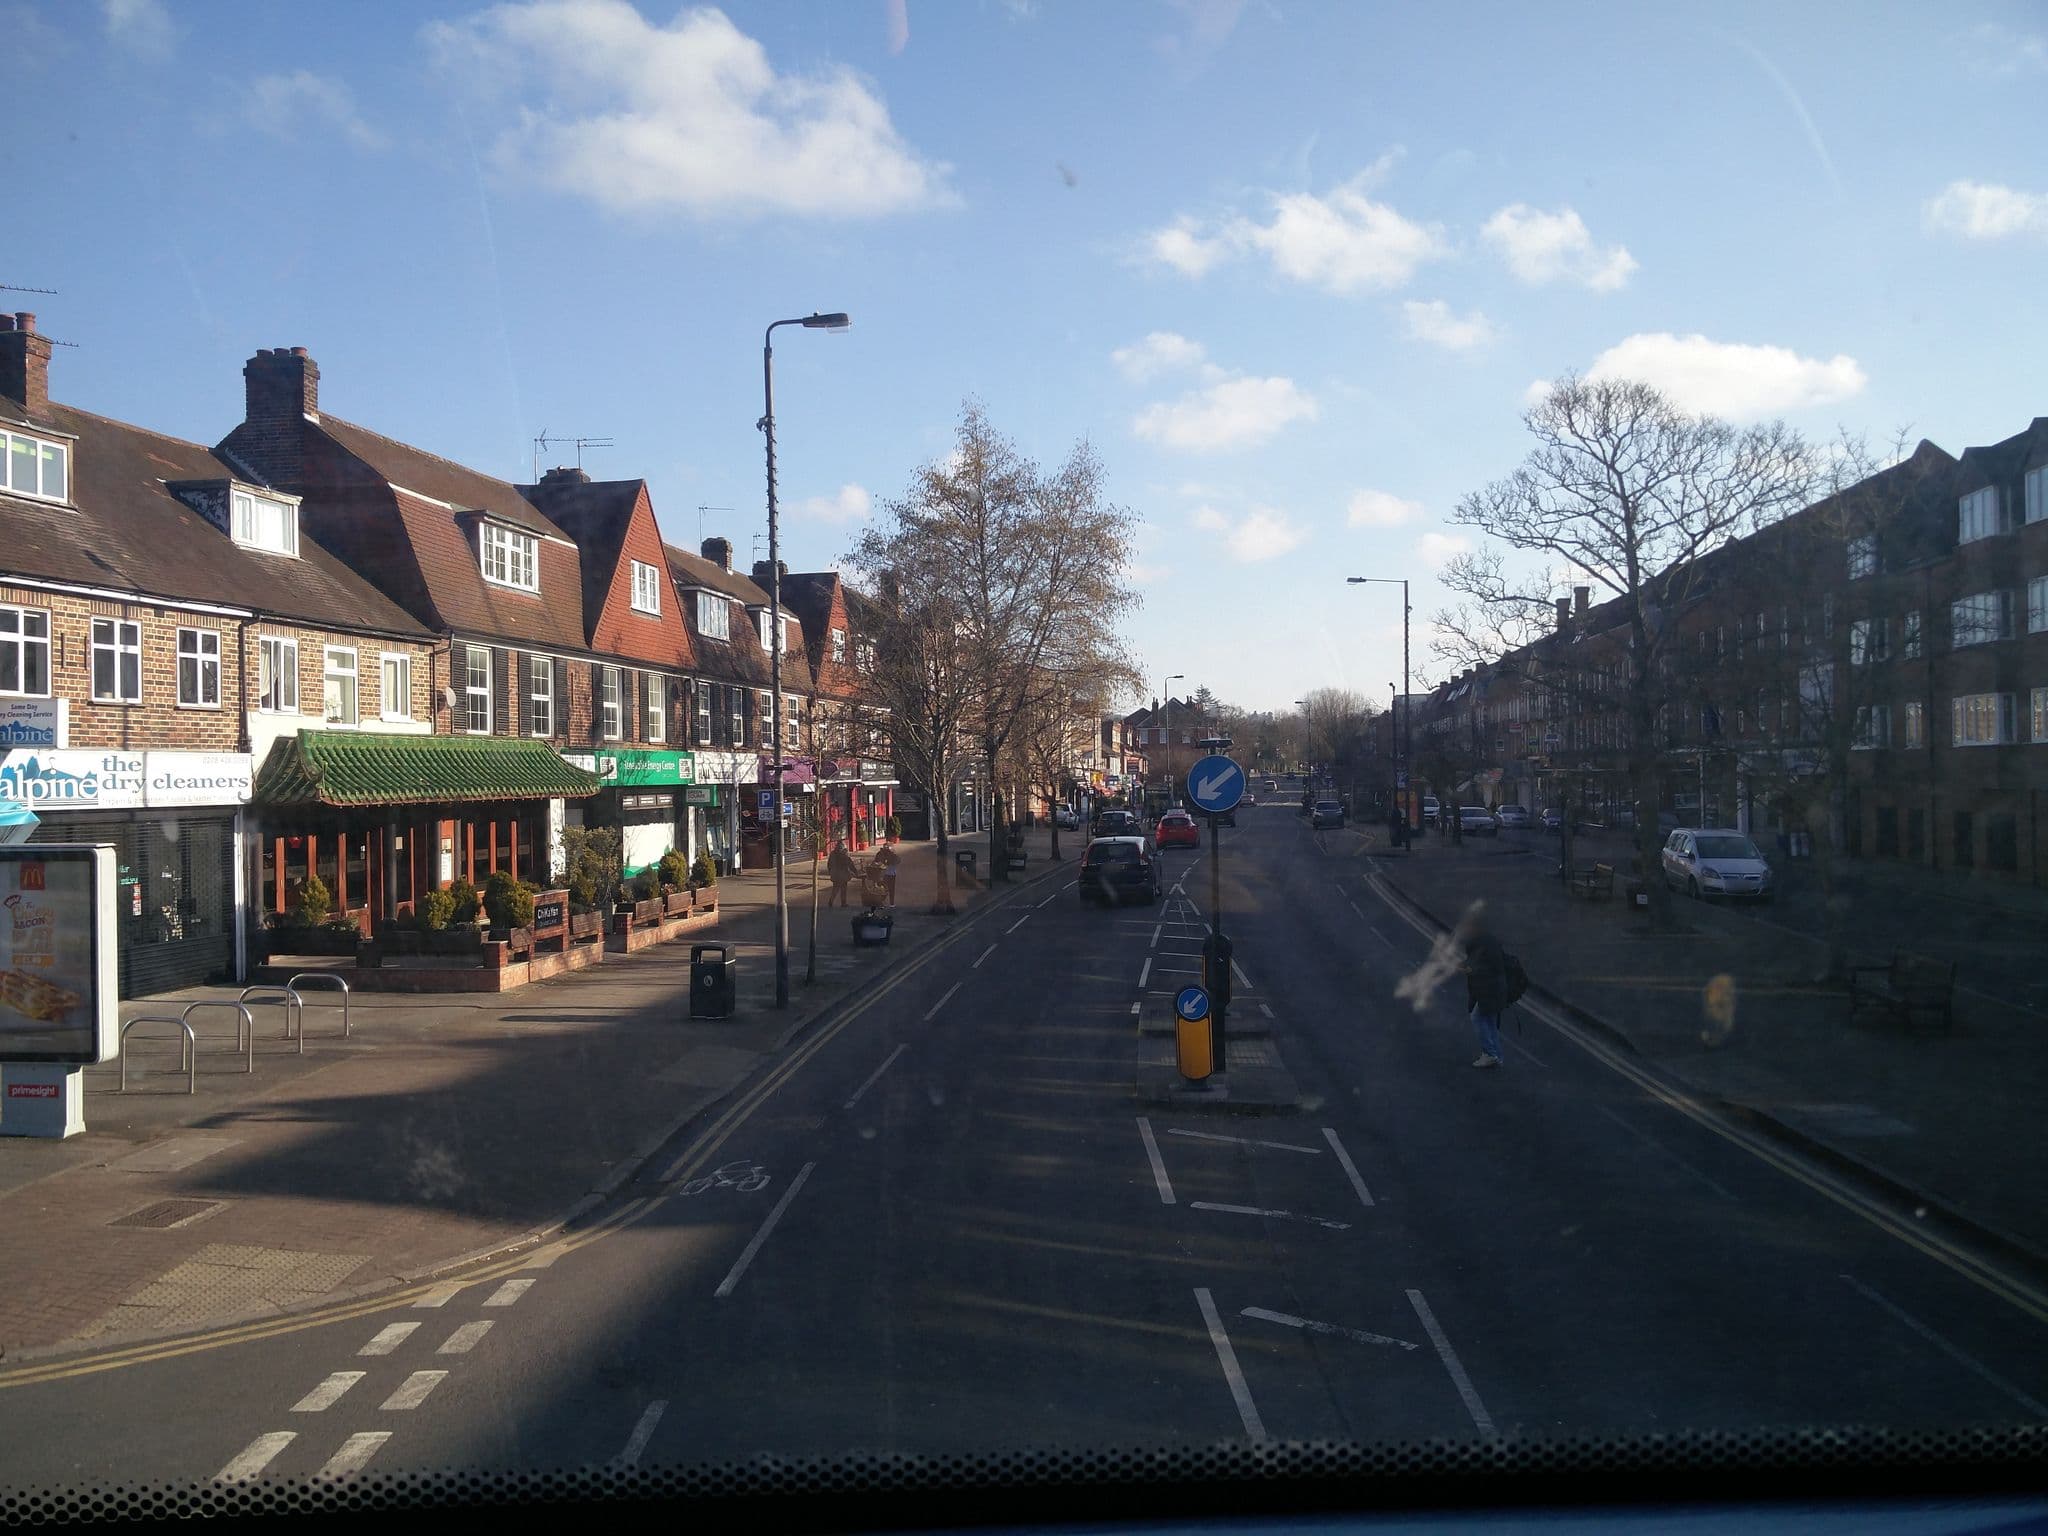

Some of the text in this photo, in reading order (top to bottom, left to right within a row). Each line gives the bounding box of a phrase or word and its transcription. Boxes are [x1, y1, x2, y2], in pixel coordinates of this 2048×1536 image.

[27, 703, 38, 712] Day
[7, 711, 32, 719] Cleaning
[0, 726, 53, 745] alpine
[101, 755, 142, 772] the
[647, 760, 662, 773] Energy
[662, 760, 676, 770] Centre
[0, 768, 98, 808] alpine
[102, 773, 249, 794] dry cleaners
[761, 792, 770, 806] P
[12, 1086, 56, 1097] primesight
